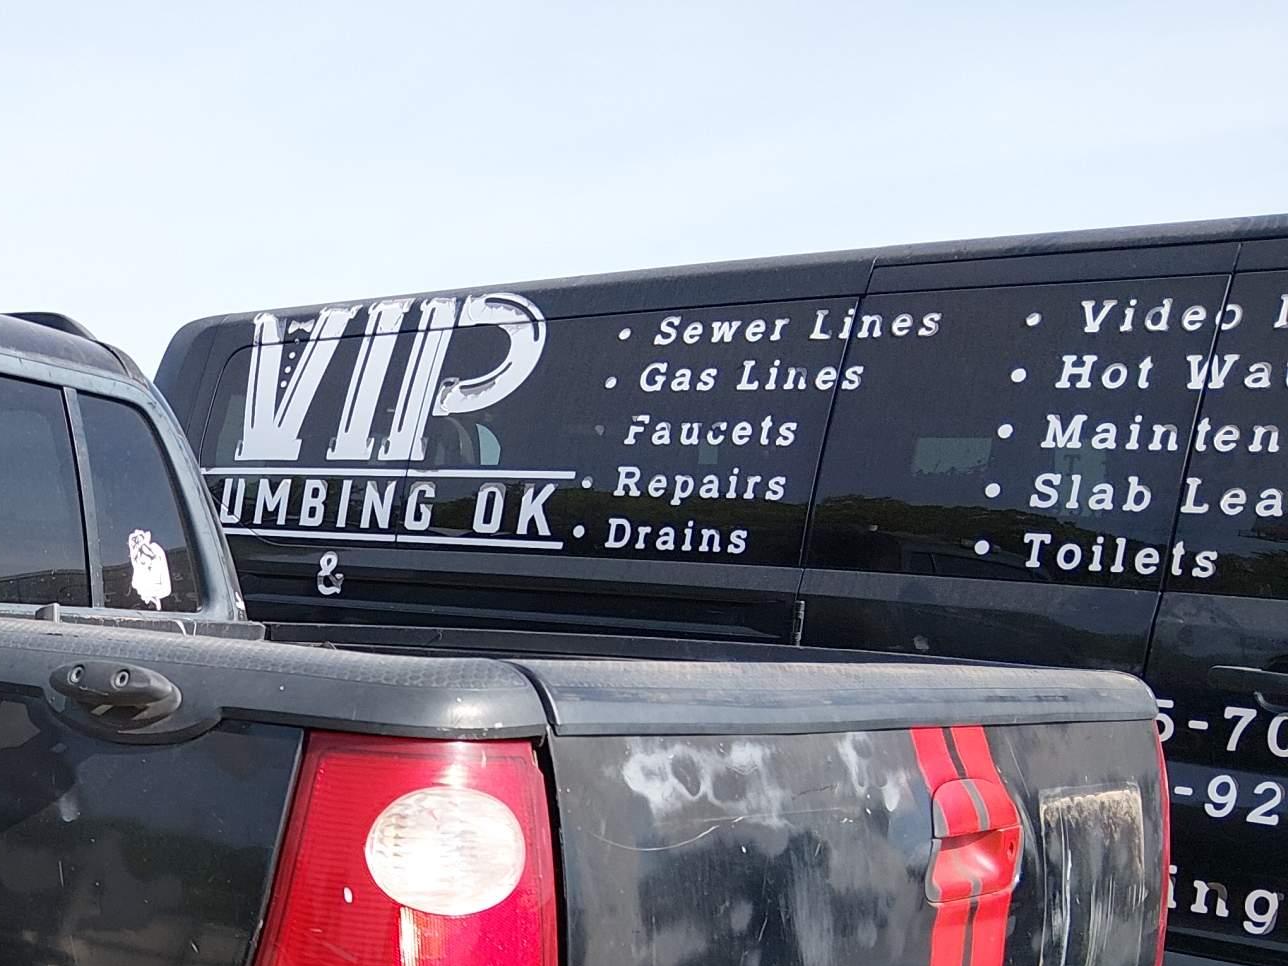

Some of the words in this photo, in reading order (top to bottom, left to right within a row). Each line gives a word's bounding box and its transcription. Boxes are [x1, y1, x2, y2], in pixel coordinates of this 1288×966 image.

[654, 315, 790, 346] Sewer
[810, 309, 943, 340] Lines
[1081, 298, 1243, 333] Video
[234, 292, 547, 461] VIP
[640, 362, 717, 392] Gas
[737, 360, 864, 392] Lines
[1055, 355, 1154, 390] Hot
[624, 414, 798, 447] Faucets
[613, 465, 787, 506] Repairs
[1029, 473, 1152, 512] Slab
[472, 482, 561, 537] OK
[604, 518, 748, 554] Drains
[317, 551, 344, 595] &
[1023, 533, 1219, 579] Toilets
